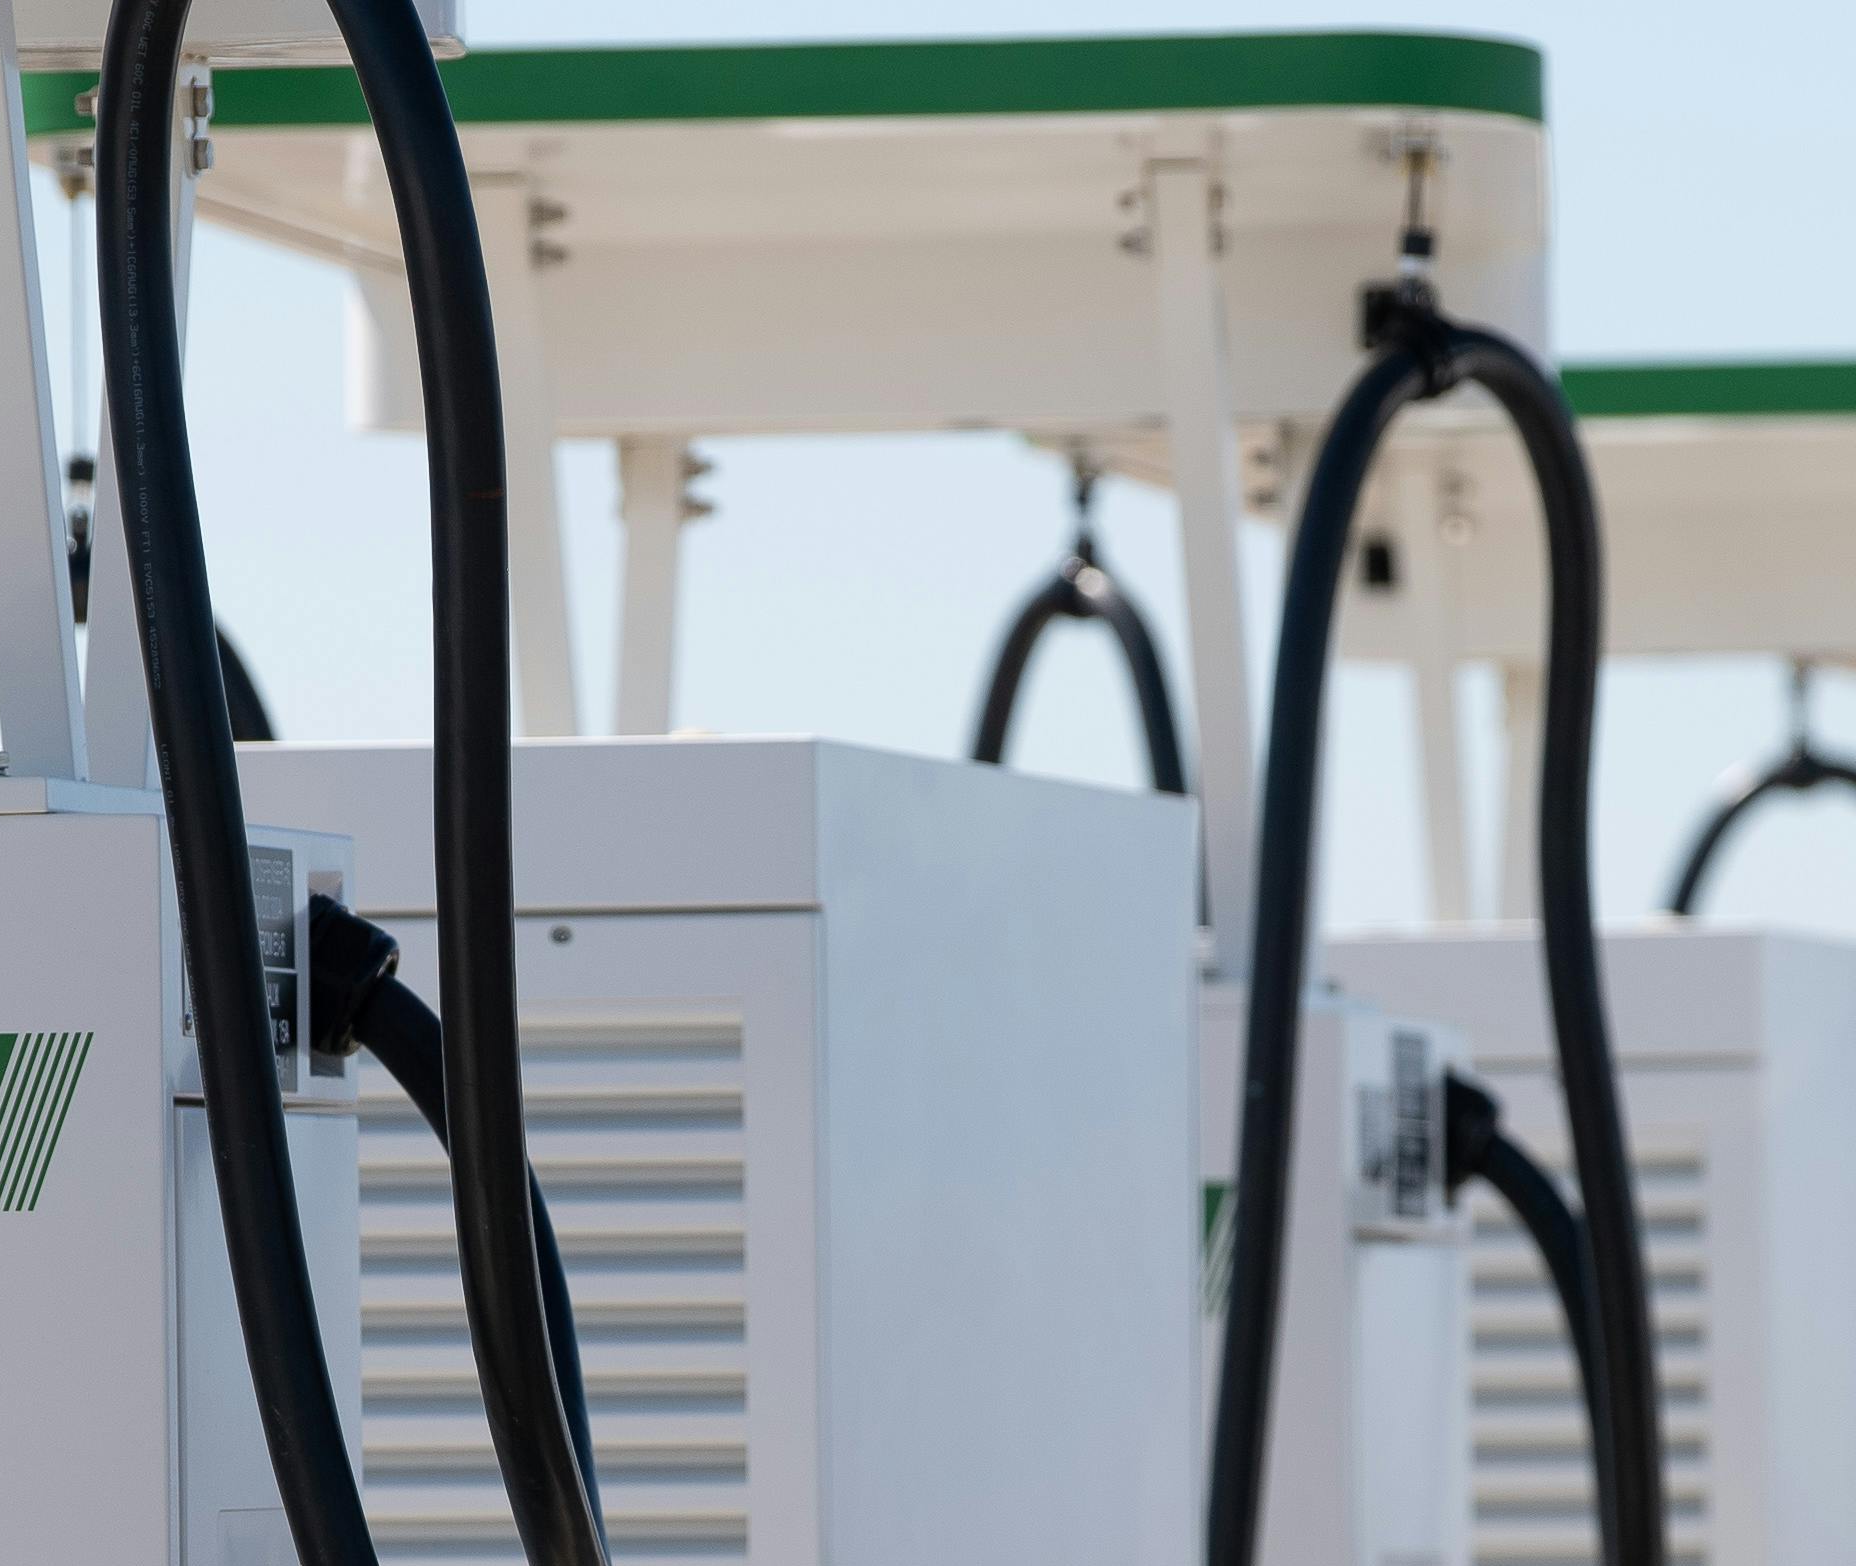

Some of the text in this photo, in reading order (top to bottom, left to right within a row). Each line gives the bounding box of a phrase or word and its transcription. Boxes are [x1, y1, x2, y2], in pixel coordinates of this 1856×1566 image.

[132, 63, 144, 86] 60C
[130, 91, 142, 113] OIL
[138, 487, 149, 524] 1000V
[160, 743, 172, 782] LEONI
